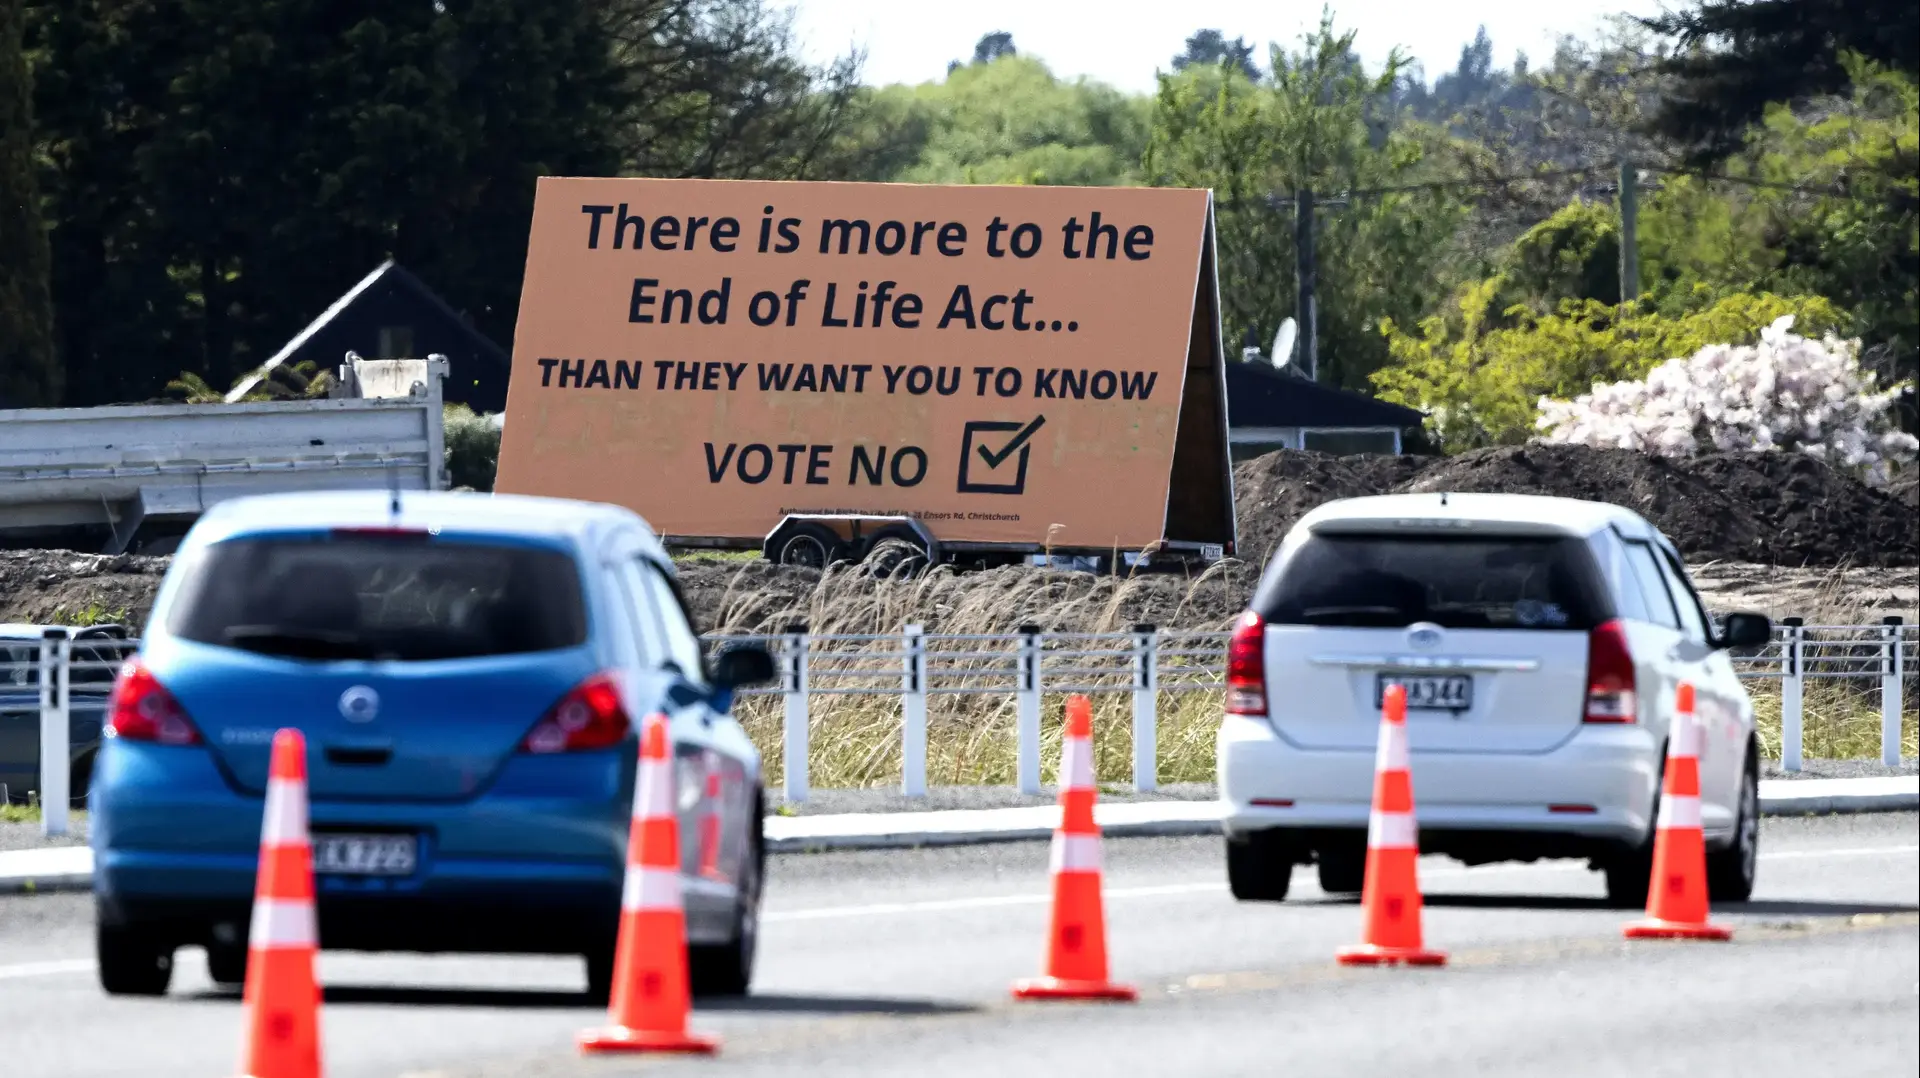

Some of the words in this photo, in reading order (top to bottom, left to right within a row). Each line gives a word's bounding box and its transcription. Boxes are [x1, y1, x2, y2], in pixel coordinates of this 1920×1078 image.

[582, 203, 741, 253] There
[758, 204, 802, 254] is
[818, 219, 968, 257] more
[985, 216, 1042, 259] to
[1061, 211, 1154, 261] the
[628, 276, 732, 325] End
[748, 279, 811, 328] of
[821, 280, 923, 330] Life
[937, 284, 1079, 333] Act...
[537, 358, 643, 390] THAN
[653, 360, 749, 391] THEY
[757, 362, 873, 393] WANT
[882, 364, 962, 396] YOU
[973, 366, 1023, 398] TO
[1033, 368, 1158, 401] KNOW
[703, 442, 834, 486] VOTE
[847, 444, 929, 488] NO
[924, 510, 951, 520] Ensors
[953, 511, 966, 521] Rd,
[968, 512, 1020, 522] Christchurch
